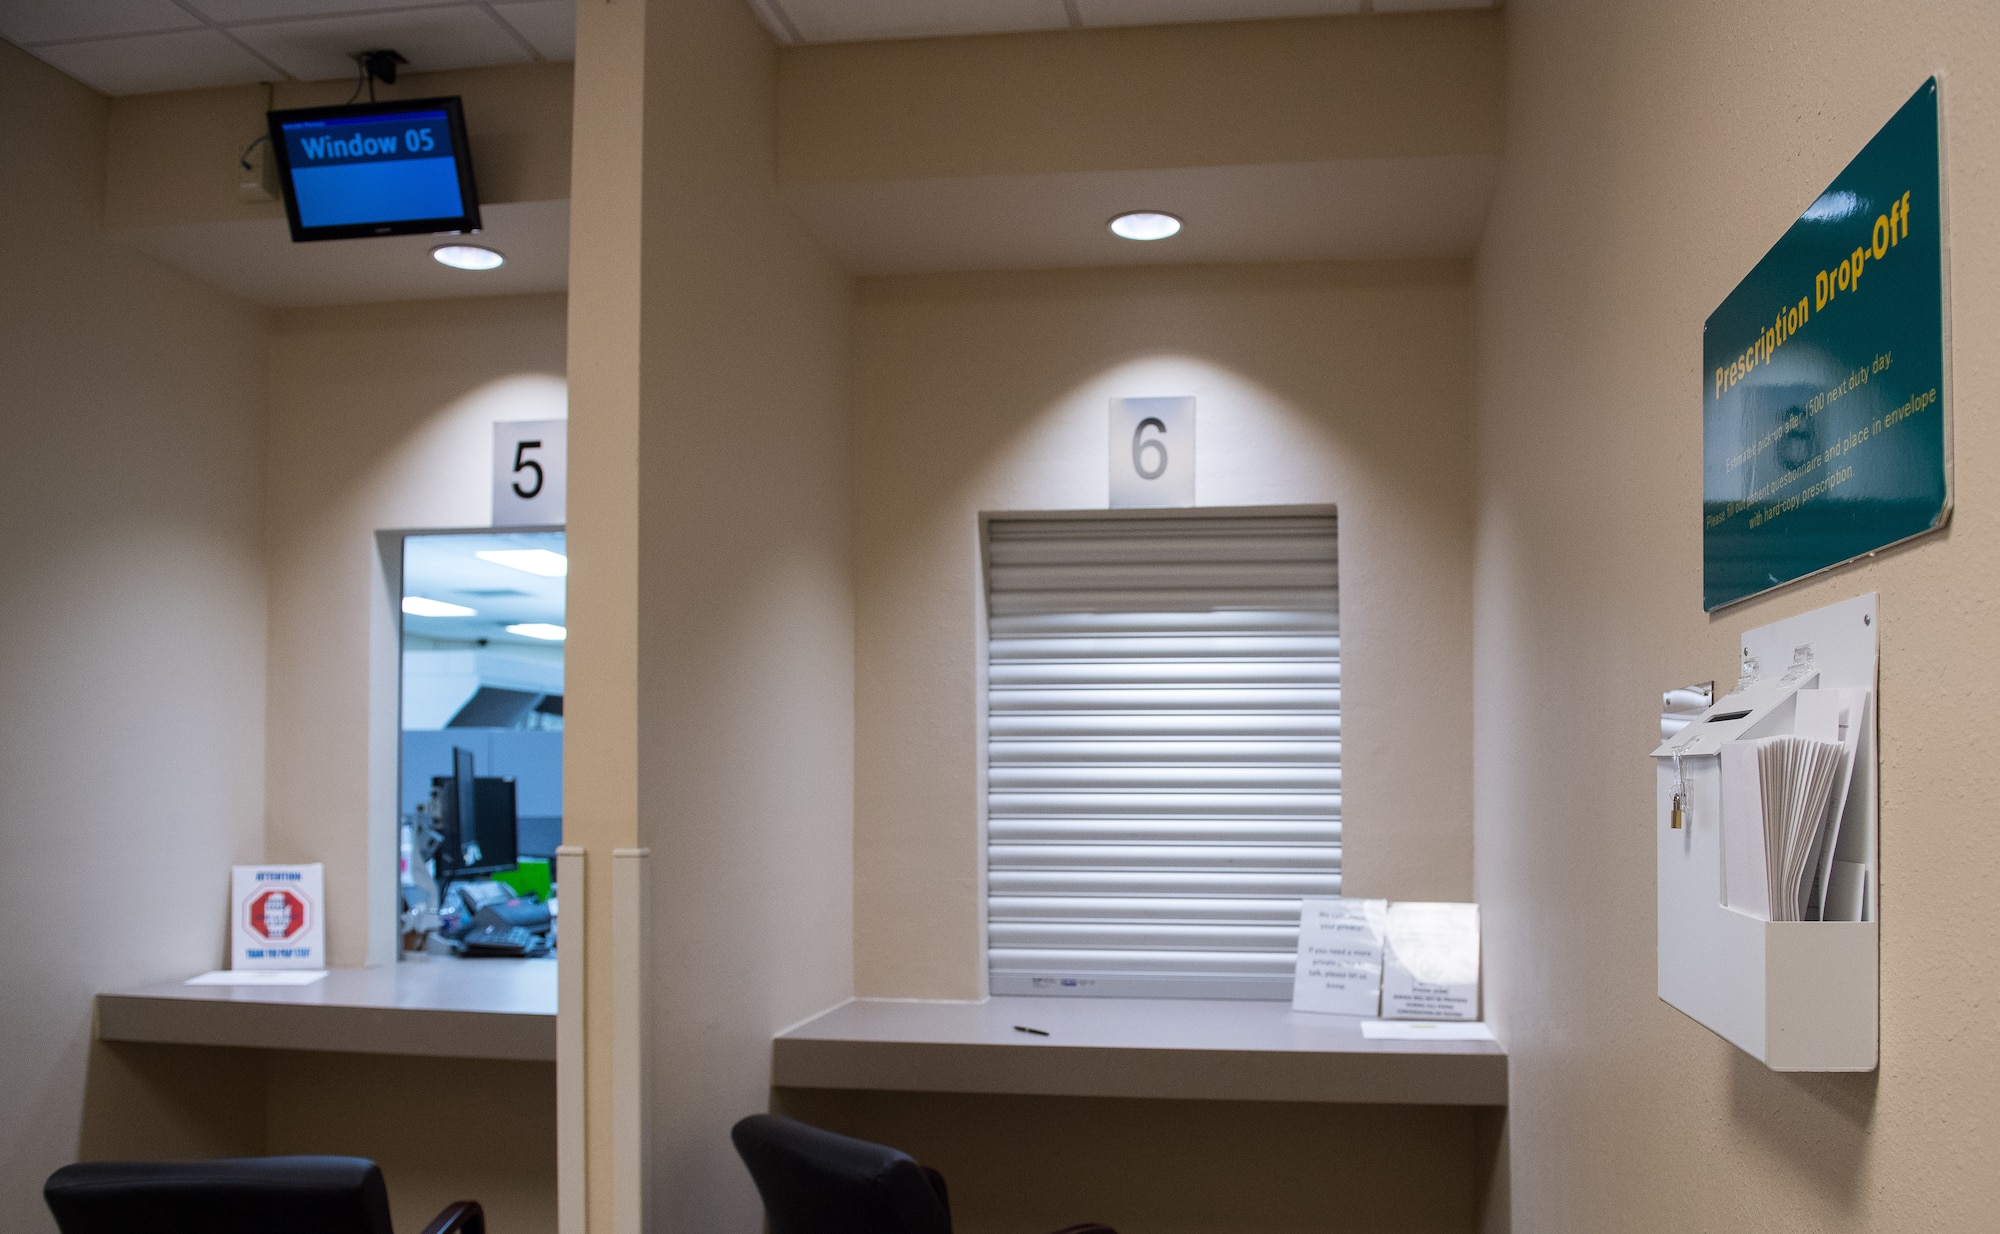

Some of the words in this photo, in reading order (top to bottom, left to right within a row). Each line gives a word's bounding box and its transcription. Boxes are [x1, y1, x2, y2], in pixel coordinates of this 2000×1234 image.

[301, 133, 398, 159] Window
[405, 128, 435, 152] 05
[1715, 296, 1808, 400] Prescription
[1816, 190, 1910, 312] Drop-Off
[1726, 445, 1756, 474] Estimated
[1758, 426, 1782, 452] pick-up
[1784, 413, 1803, 433] after
[1805, 392, 1824, 418] 1500
[1826, 380, 1848, 405] next
[1849, 366, 1870, 390] duty
[1872, 351, 1893, 374] day.
[511, 439, 544, 499] 5
[1132, 416, 1169, 481] 6
[1706, 511, 1726, 530] Please
[1727, 502, 1735, 518] fill
[1735, 499, 1746, 513] out
[1746, 482, 1770, 510] patient
[1771, 454, 1821, 495] questionnaire
[1824, 438, 1841, 463] and
[1843, 426, 1869, 455] place
[1872, 417, 1882, 436] in
[1885, 388, 1937, 428] envelope
[1749, 509, 1762, 529] with
[1764, 493, 1800, 521] hard-copy
[1802, 465, 1856, 505] prescription.
